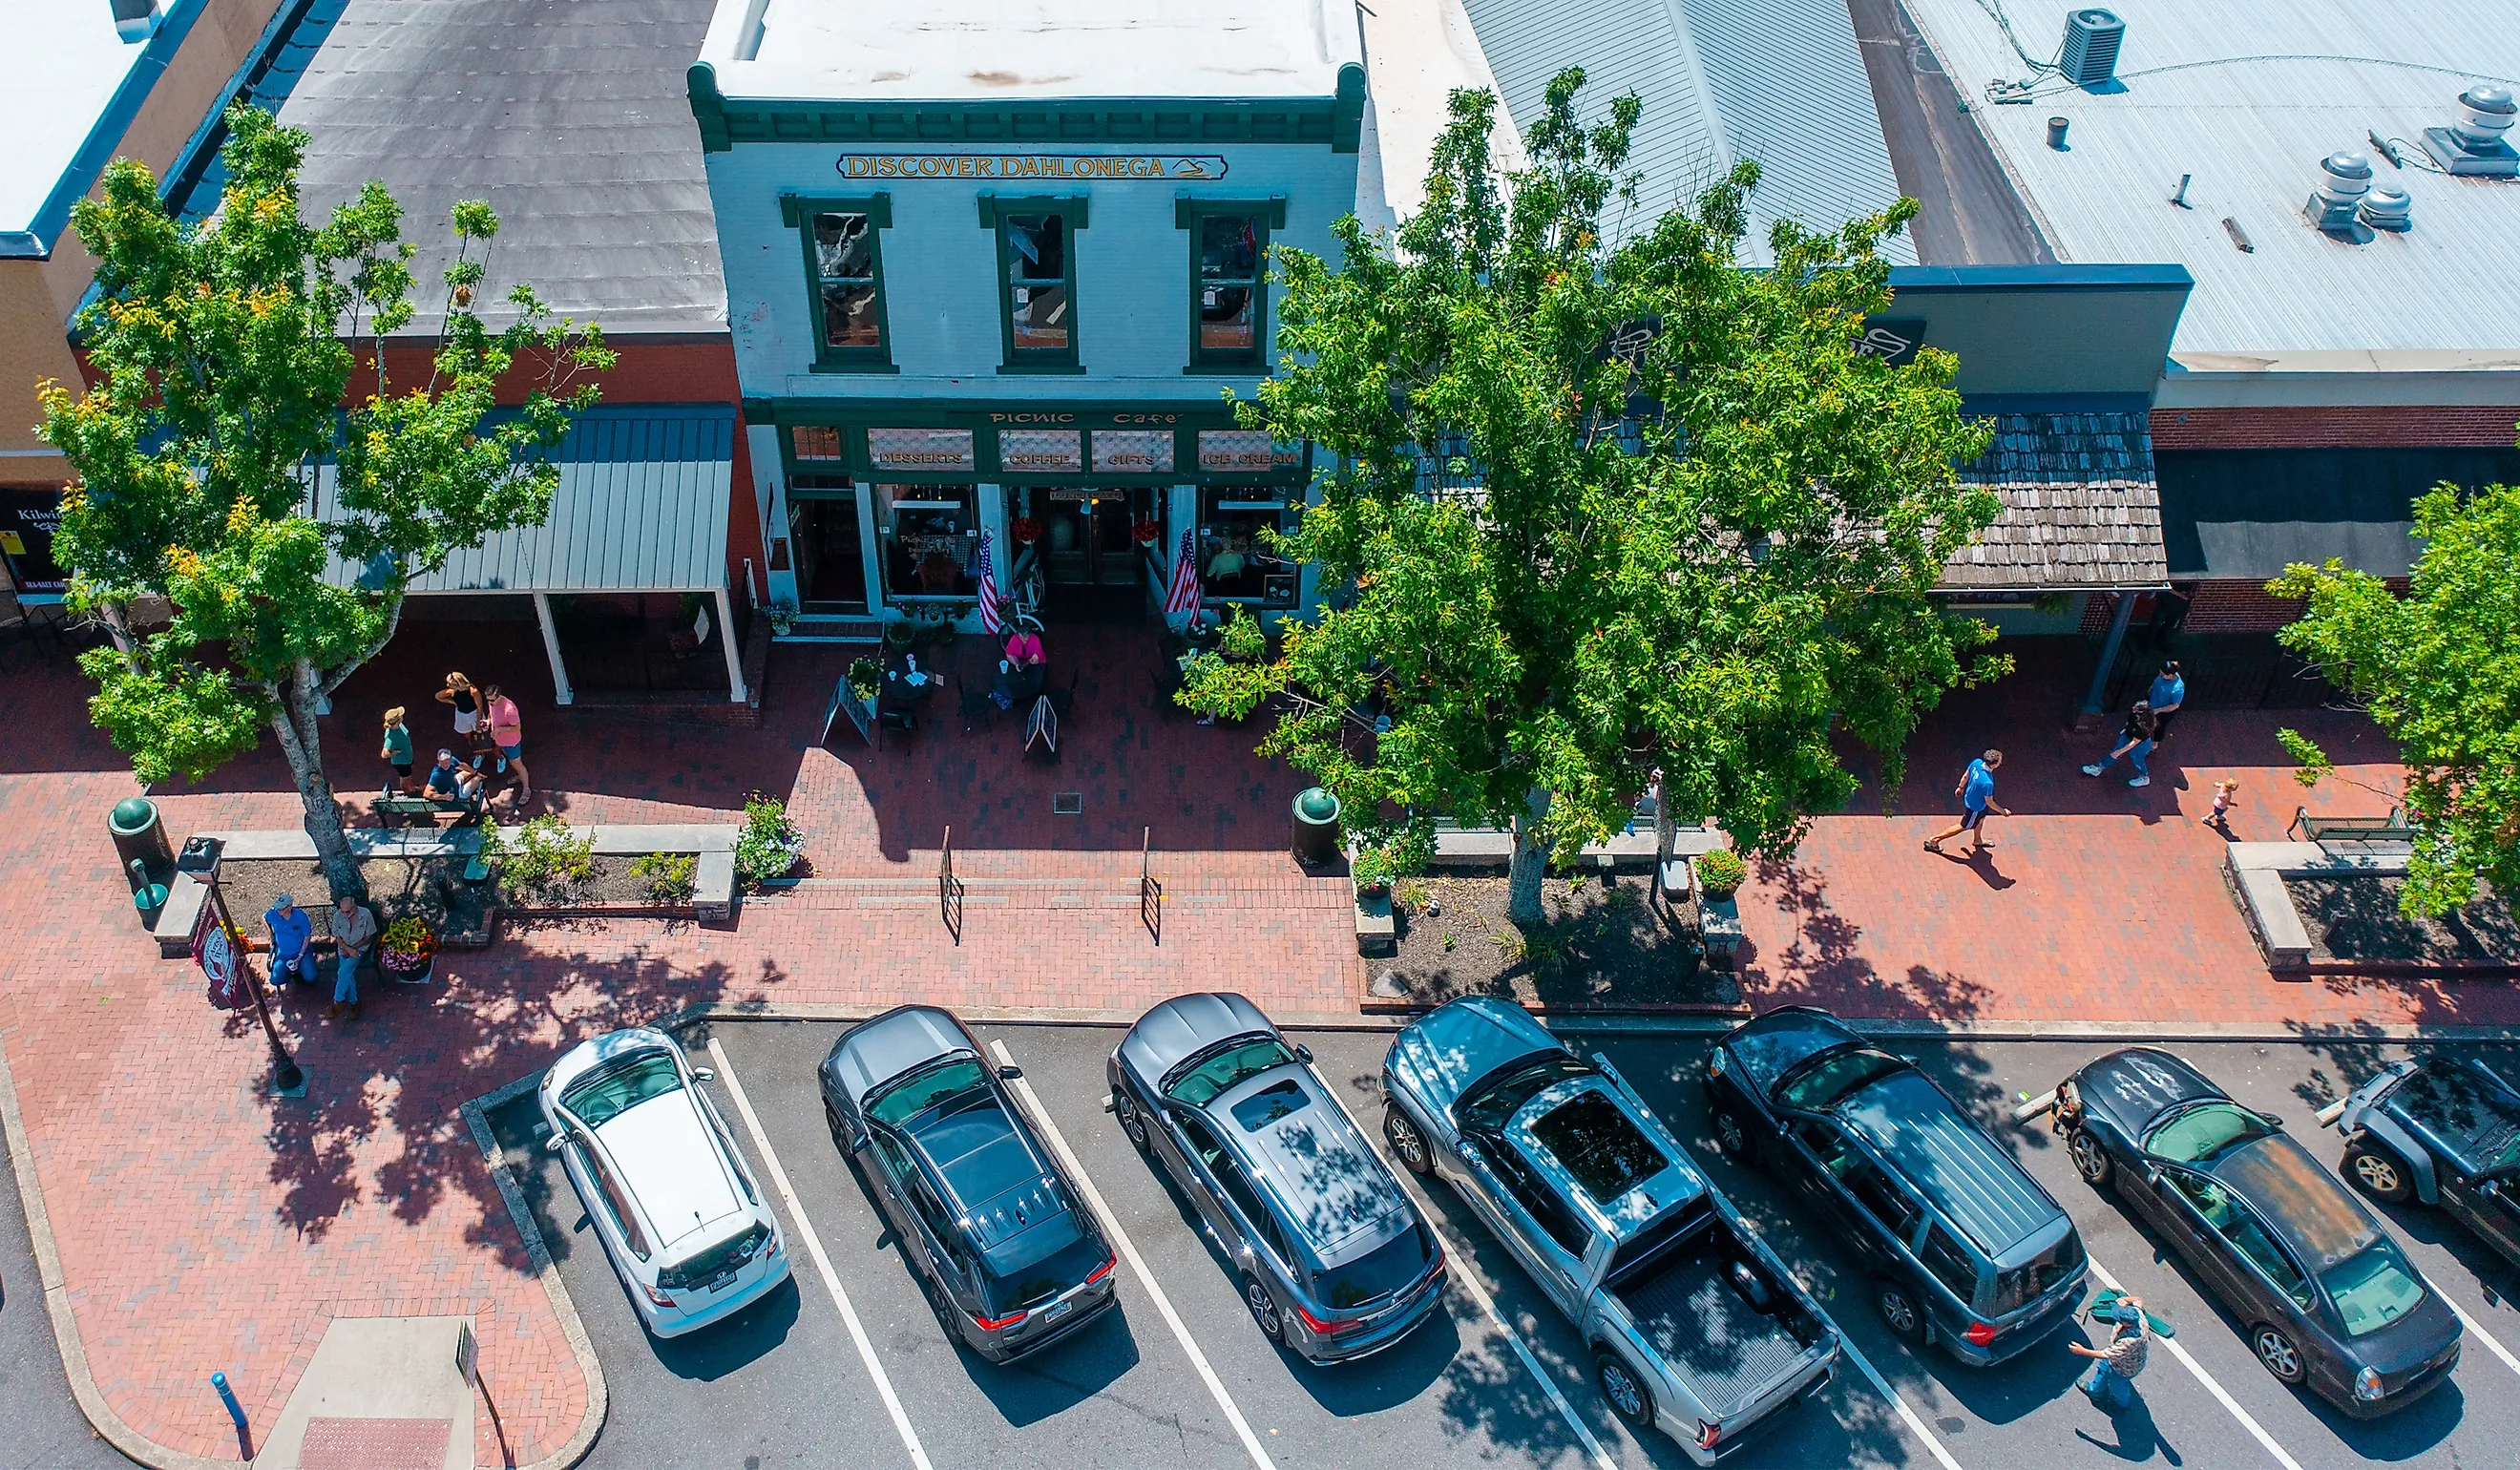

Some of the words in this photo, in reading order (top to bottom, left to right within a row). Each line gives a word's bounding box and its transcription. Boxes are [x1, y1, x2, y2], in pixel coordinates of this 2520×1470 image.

[848, 158, 995, 177] DISCOVER
[999, 158, 1166, 177] DAHLONEGA
[879, 452, 963, 464] DESSERTS
[1009, 453, 1072, 465] COFFEE
[1107, 453, 1156, 465] GIFTS
[1202, 453, 1231, 465] ICE
[1238, 453, 1297, 464] CREAM
